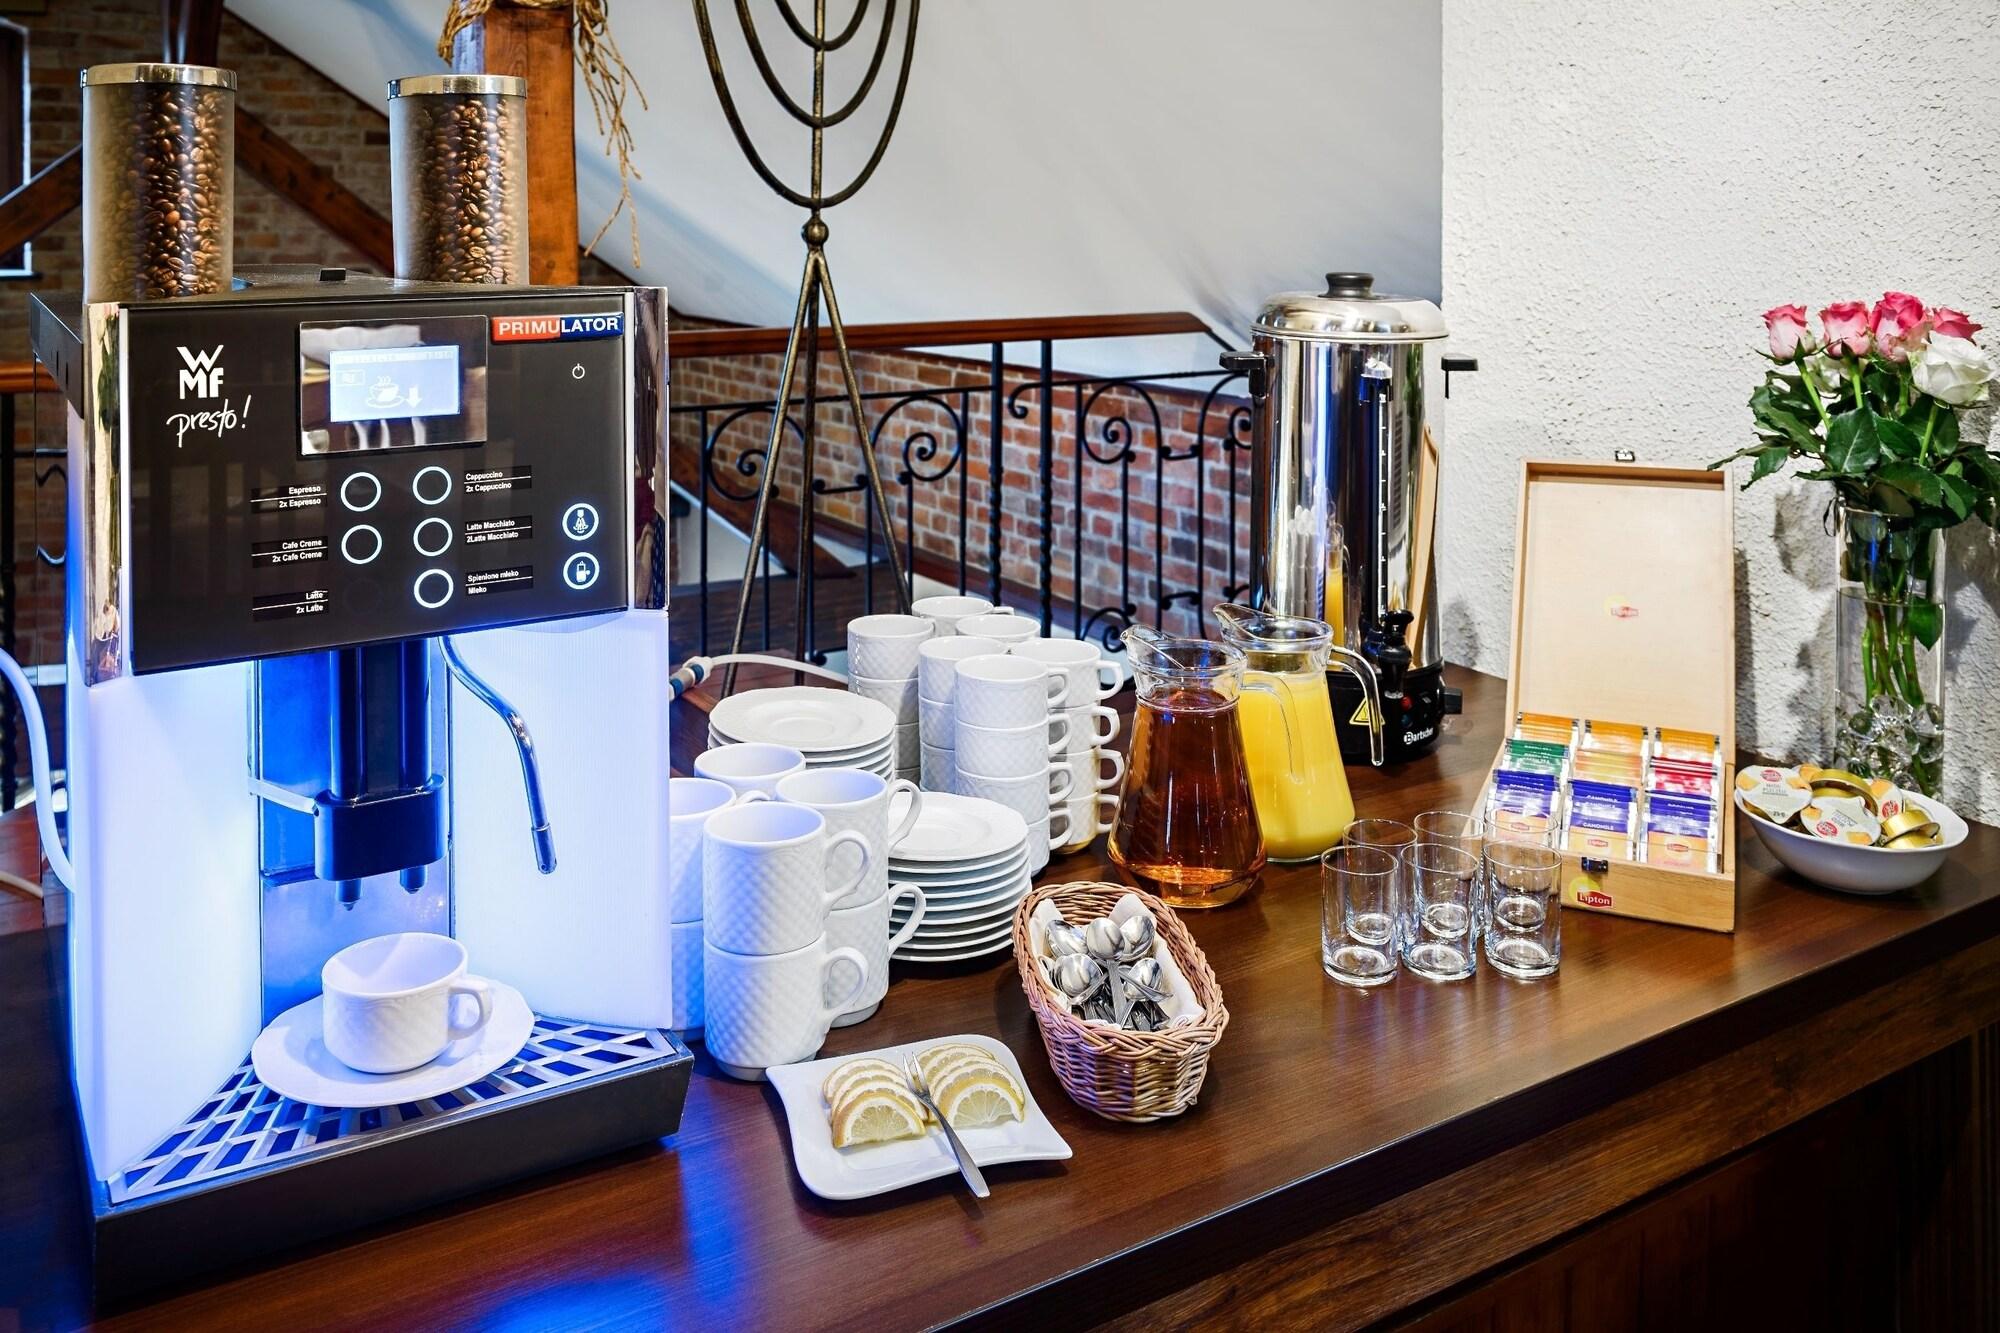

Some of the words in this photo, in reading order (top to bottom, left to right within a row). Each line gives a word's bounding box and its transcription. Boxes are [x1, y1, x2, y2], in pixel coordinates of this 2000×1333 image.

[498, 317, 620, 336] PRIMULATOR
[176, 344, 224, 400] WMF
[465, 471, 503, 482] Cappuccino
[288, 485, 321, 496] Espresso
[465, 485, 474, 493] 2x
[474, 482, 512, 492] Cappuccino
[279, 500, 288, 508] 2x
[288, 497, 321, 507] Espresso
[466, 522, 482, 531] Latte
[483, 519, 515, 529] Macchiato
[487, 531, 519, 541] Macchiato
[282, 541, 299, 550] Cafe
[299, 539, 323, 548] Creme
[272, 555, 281, 563] 2x
[282, 554, 299, 562] Cafe
[299, 551, 323, 560] Creme
[468, 586, 487, 595] Mleko
[296, 606, 305, 614] 2x
[305, 604, 324, 613] Latte
[1579, 893, 1611, 905] Lipton
